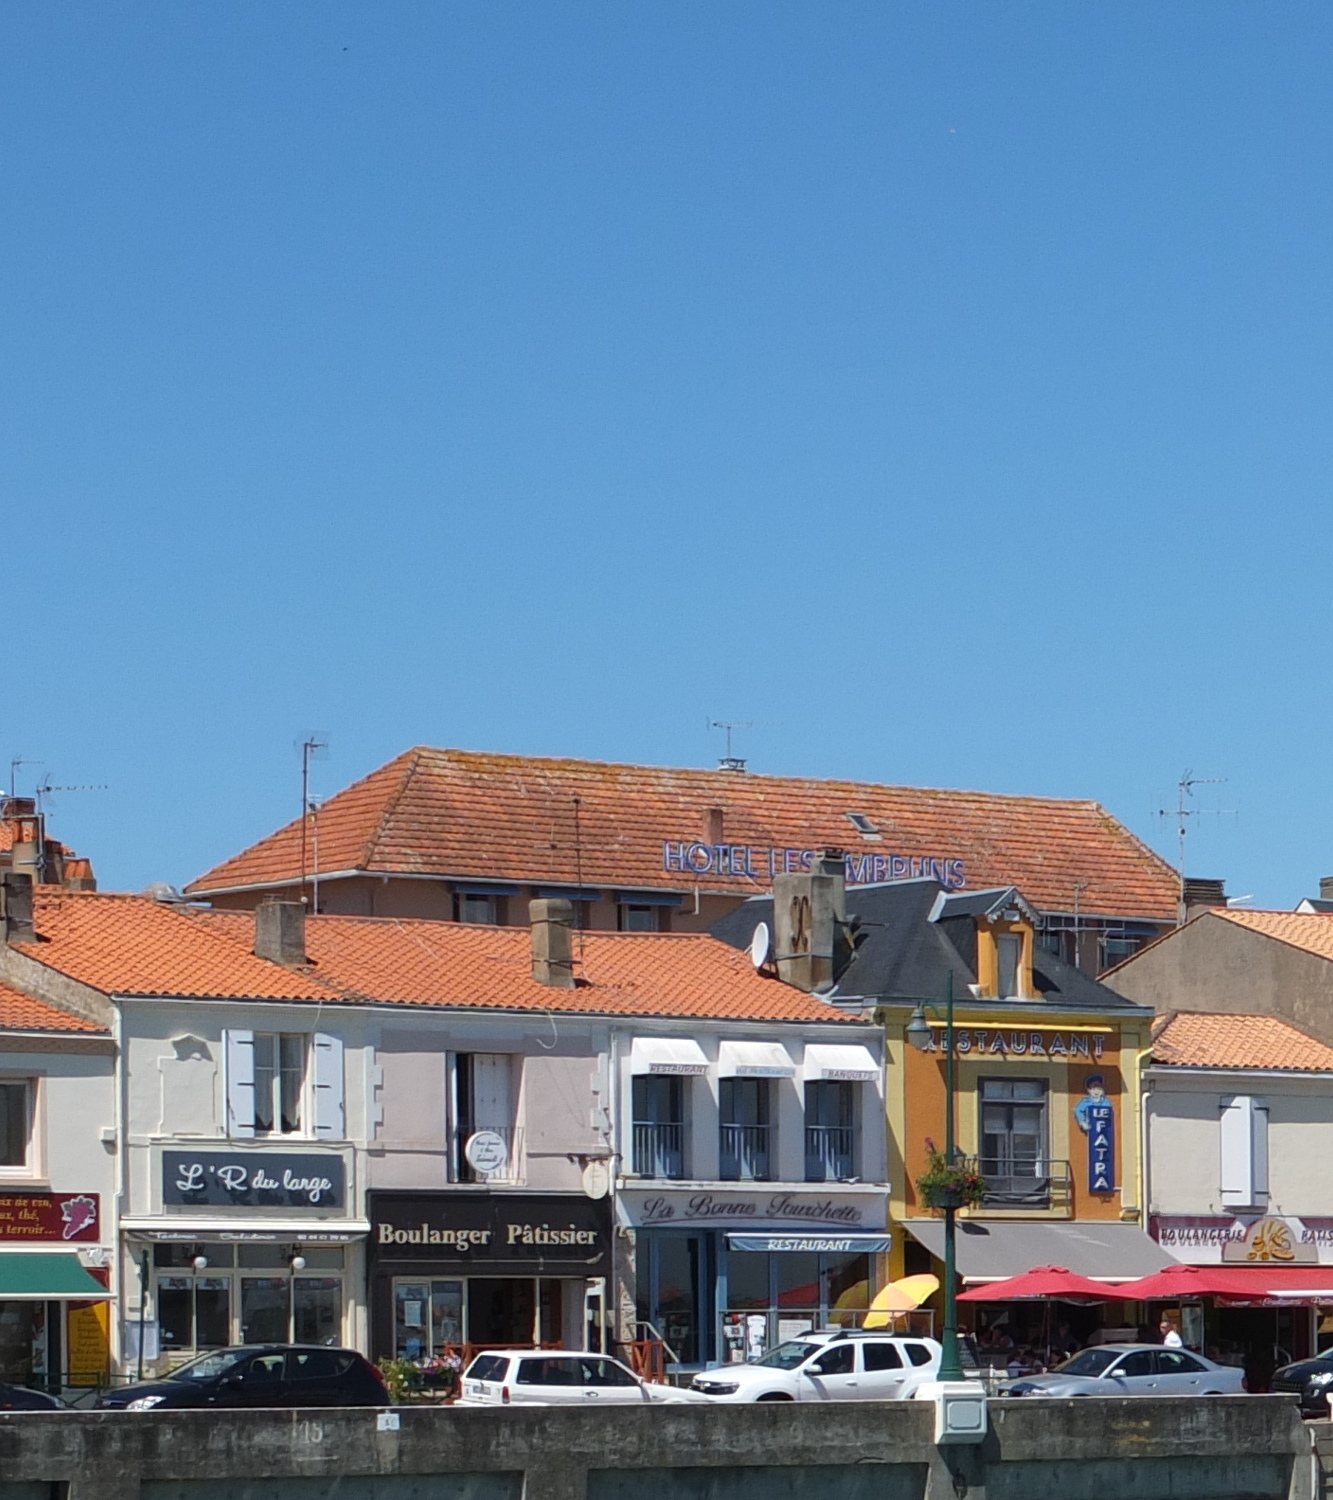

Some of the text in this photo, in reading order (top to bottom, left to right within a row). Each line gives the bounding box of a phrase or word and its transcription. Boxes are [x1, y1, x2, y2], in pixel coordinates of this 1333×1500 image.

[664, 840, 760, 877] HOTEL
[1093, 1108, 1110, 1118] LE
[252, 1169, 280, 1189] du
[640, 1200, 675, 1222] La
[684, 1194, 757, 1217] Bonne
[378, 1223, 598, 1251] Boulanger Pâtissier
[767, 1239, 852, 1250] RESTAURANT
